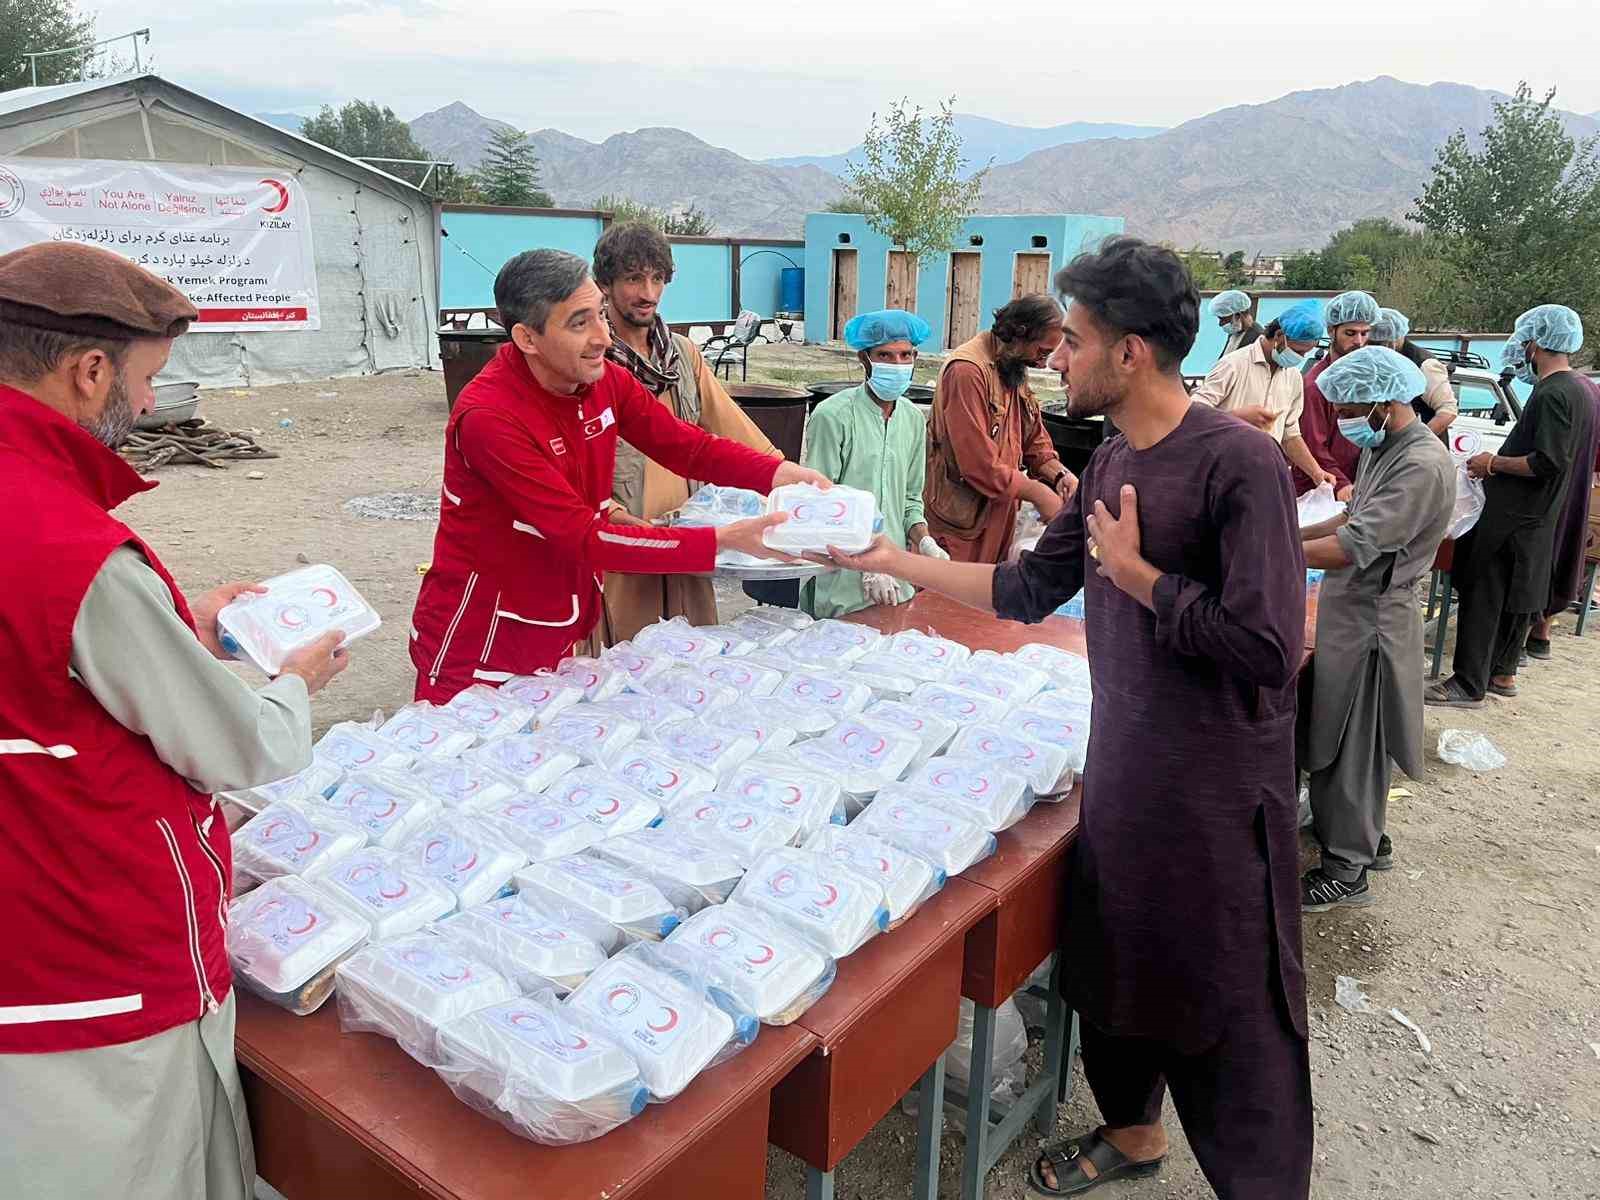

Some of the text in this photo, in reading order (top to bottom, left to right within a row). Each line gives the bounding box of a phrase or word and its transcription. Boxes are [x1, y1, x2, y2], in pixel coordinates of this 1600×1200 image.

[102, 188, 145, 199] You Are
[99, 199, 151, 211] Not Alone
[260, 220, 291, 229] KIZILAY
[118, 230, 142, 243] برای
[169, 232, 196, 245] غذای
[199, 232, 230, 245] برنامه
[177, 275, 216, 285] Yemek
[255, 293, 291, 304] People
